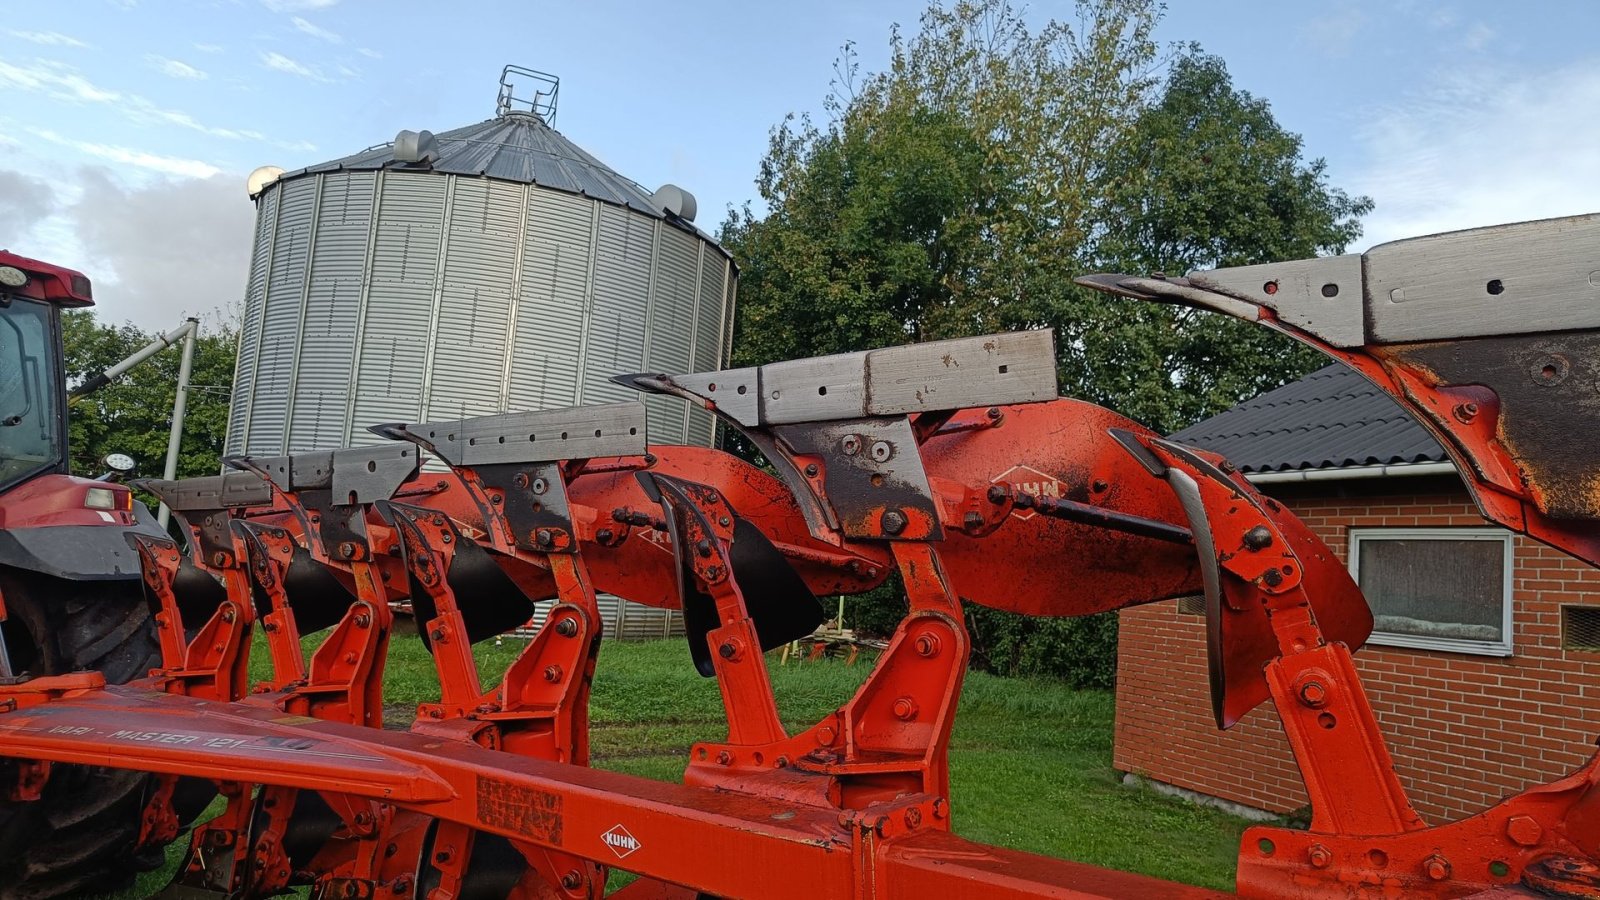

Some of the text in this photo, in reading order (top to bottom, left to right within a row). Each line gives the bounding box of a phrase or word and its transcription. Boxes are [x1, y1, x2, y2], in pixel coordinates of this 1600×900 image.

[48, 725, 95, 736] VARI
[107, 730, 199, 745] MASTER
[203, 738, 248, 749] 121
[606, 832, 635, 850] KUHN
